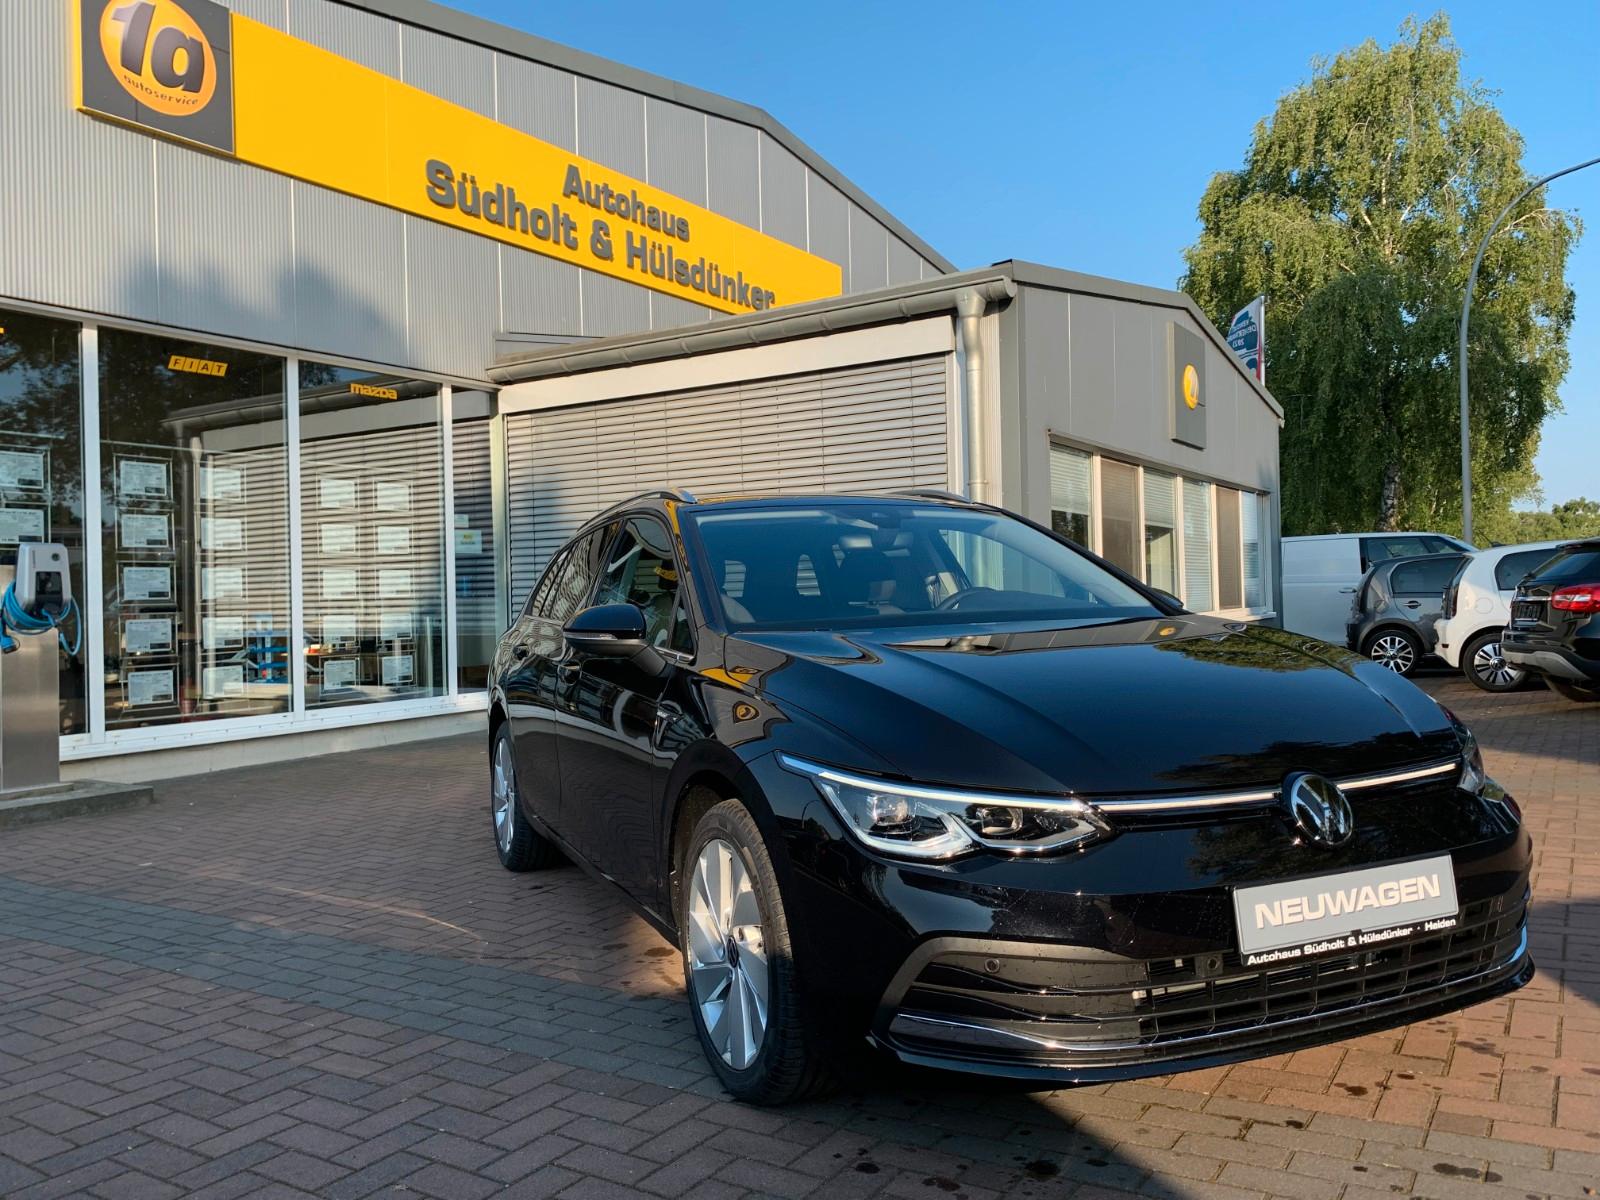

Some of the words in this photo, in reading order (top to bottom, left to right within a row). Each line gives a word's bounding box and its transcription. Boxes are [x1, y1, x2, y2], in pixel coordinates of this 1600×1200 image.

[124, 75, 198, 105] autoservice
[563, 164, 690, 242] Autohaus
[425, 159, 578, 250] Südholt
[590, 219, 614, 261] &
[626, 230, 775, 310] Hülsdünker
[170, 356, 226, 376] FIAT
[1254, 873, 1441, 929] NEUWAGEN
[1247, 948, 1302, 966] Autohaus
[1303, 940, 1345, 955] Südholt
[1347, 936, 1357, 946] &
[1358, 926, 1413, 944] Hülsdünker
[1424, 918, 1457, 931] Heiden
